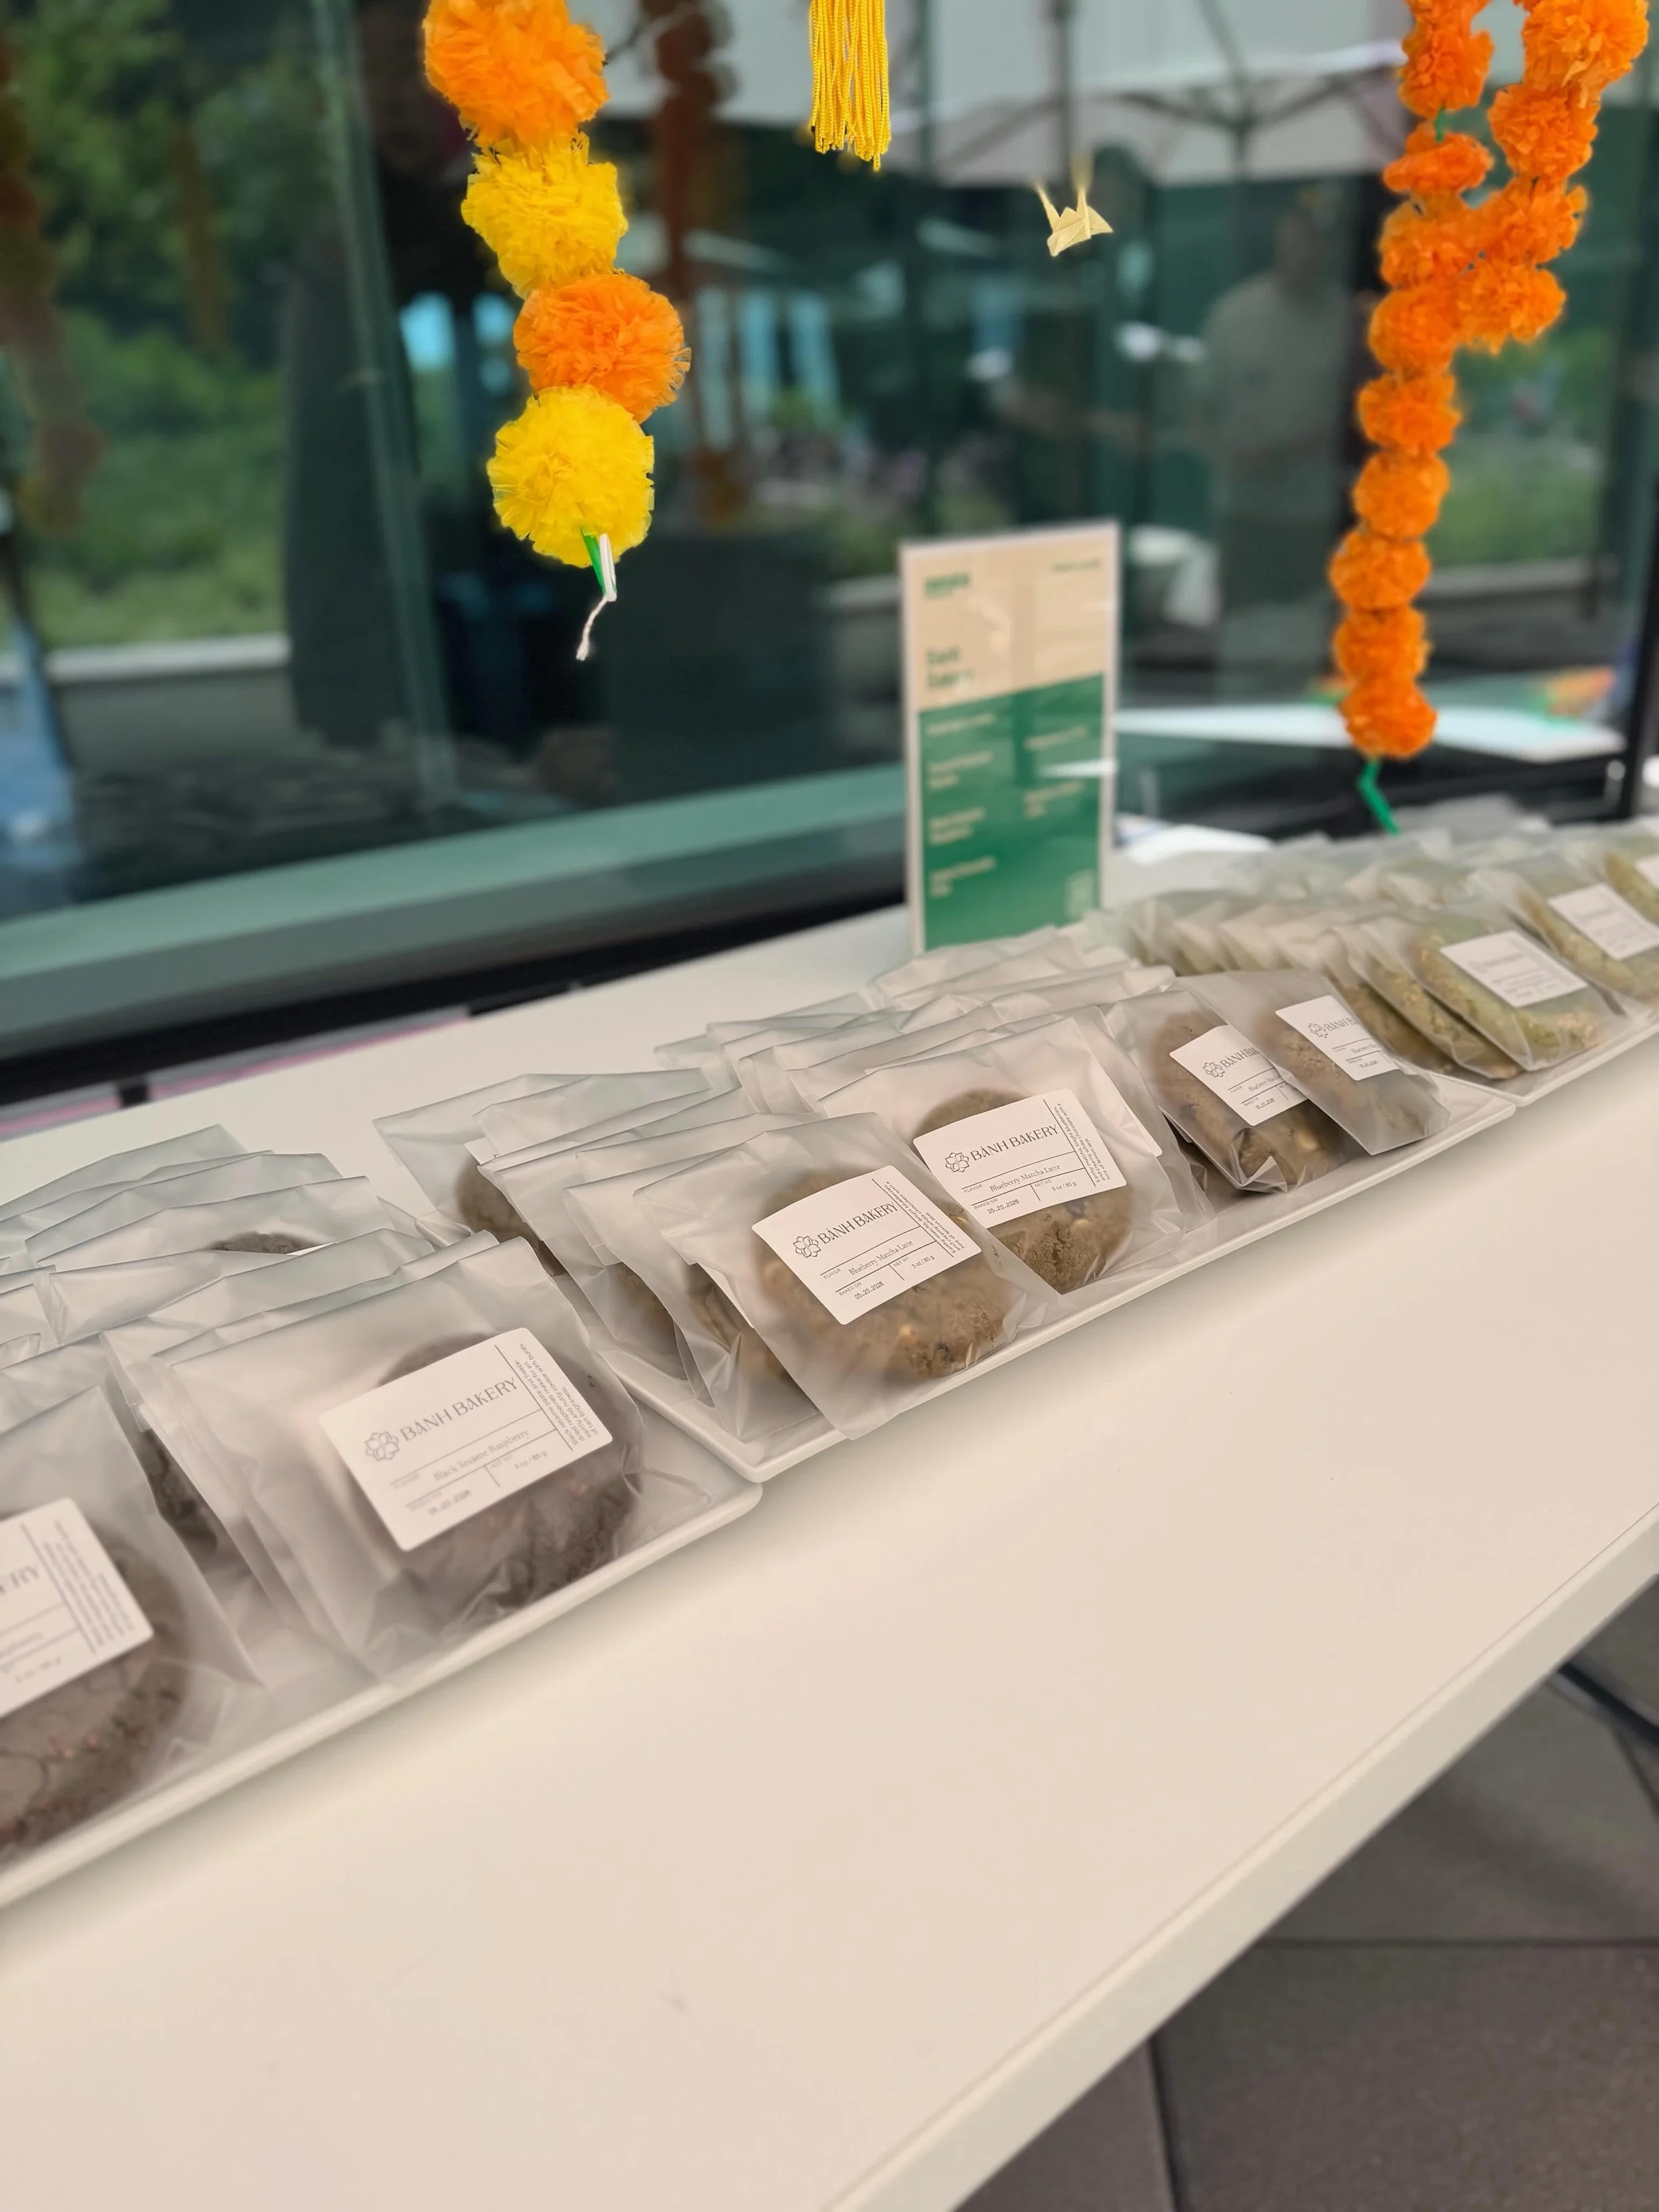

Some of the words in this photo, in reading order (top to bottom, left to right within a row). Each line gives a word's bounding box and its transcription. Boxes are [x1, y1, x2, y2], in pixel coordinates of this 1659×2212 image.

[970, 1140, 1009, 1161] BÁNH
[1009, 1125, 1058, 1147] BAKERY
[989, 1178, 1020, 1192] Blueberry
[1020, 1170, 1045, 1181] Matcha
[1043, 1165, 1060, 1173] Latte
[964, 1183, 983, 1193] FLAVOR
[817, 1220, 855, 1244] BÁNH
[852, 1203, 897, 1226] BAKERY
[848, 1258, 878, 1276] Blueberry
[875, 1248, 899, 1261] Matcha
[897, 1240, 913, 1250] Latte
[530, 1370, 538, 1378] for
[532, 1360, 543, 1373] with
[526, 1378, 538, 1390] and
[536, 1377, 550, 1394] make
[541, 1373, 557, 1391] cookie
[536, 1390, 551, 1406] paste
[555, 1391, 569, 1407] nutty
[399, 1408, 453, 1441] BÁNH
[452, 1378, 516, 1416] BAKERY
[548, 1406, 566, 1428] sesame
[566, 1407, 578, 1419] and
[564, 1428, 579, 1445] Black
[576, 1419, 592, 1438] earthy
[433, 1465, 458, 1481] Black
[457, 1450, 488, 1469] Sesame
[488, 1430, 529, 1453] Raspberry
